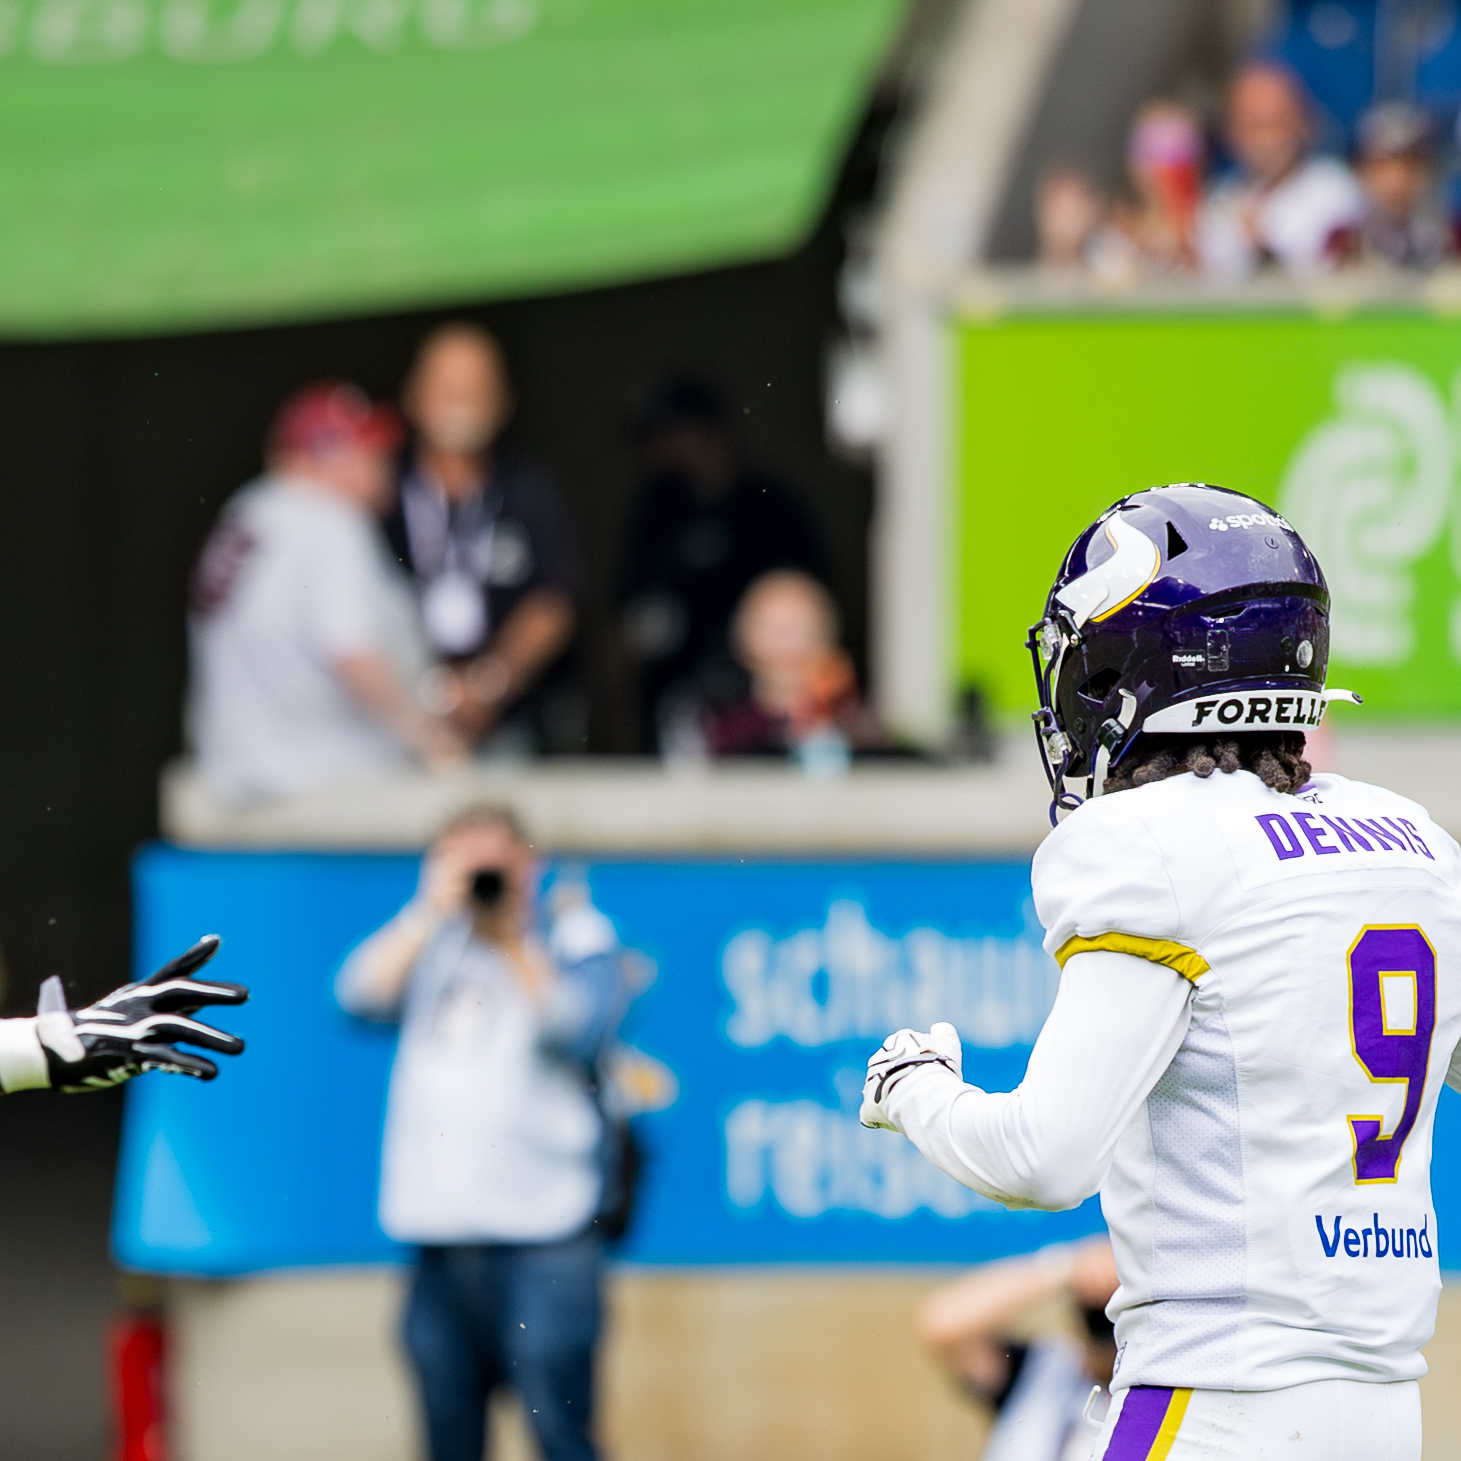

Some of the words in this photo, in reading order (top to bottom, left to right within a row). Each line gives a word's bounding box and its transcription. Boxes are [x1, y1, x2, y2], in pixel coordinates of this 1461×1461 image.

[1254, 811, 1435, 861] DENNIS
[1347, 923, 1437, 1185] 9
[1315, 1212, 1433, 1258] Verbund
